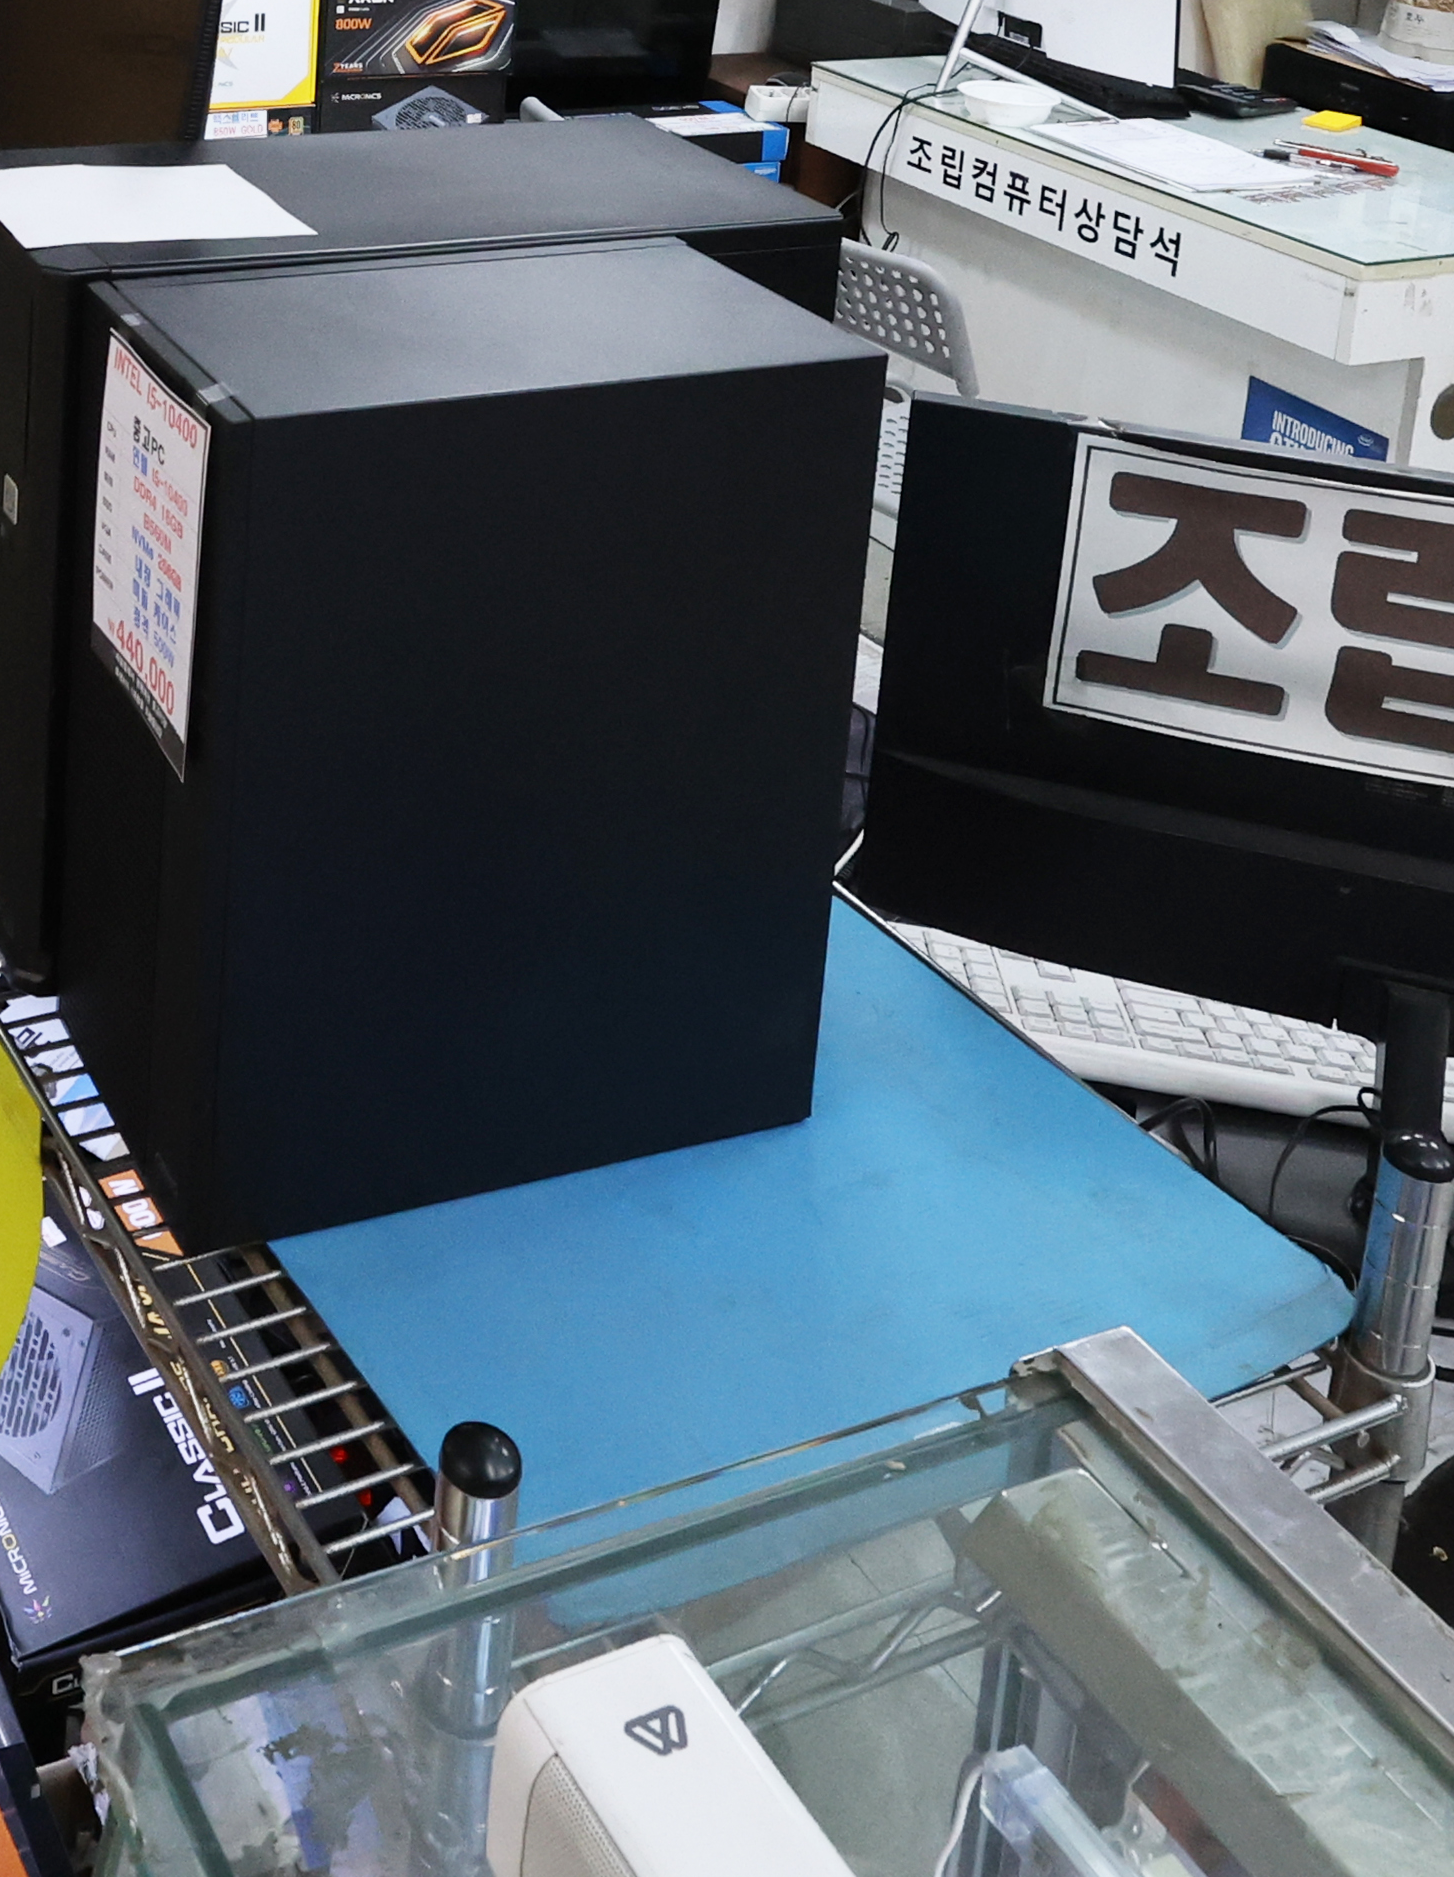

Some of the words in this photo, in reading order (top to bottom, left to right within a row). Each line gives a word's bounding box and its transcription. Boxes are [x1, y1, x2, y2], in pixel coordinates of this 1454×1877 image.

[335, 18, 372, 31] 800W
[906, 134, 1183, 279] 조립컴퓨터상담석
[114, 346, 142, 398] INTEL
[132, 415, 166, 466] 중고PC
[153, 1392, 245, 1545] CLASSIC
